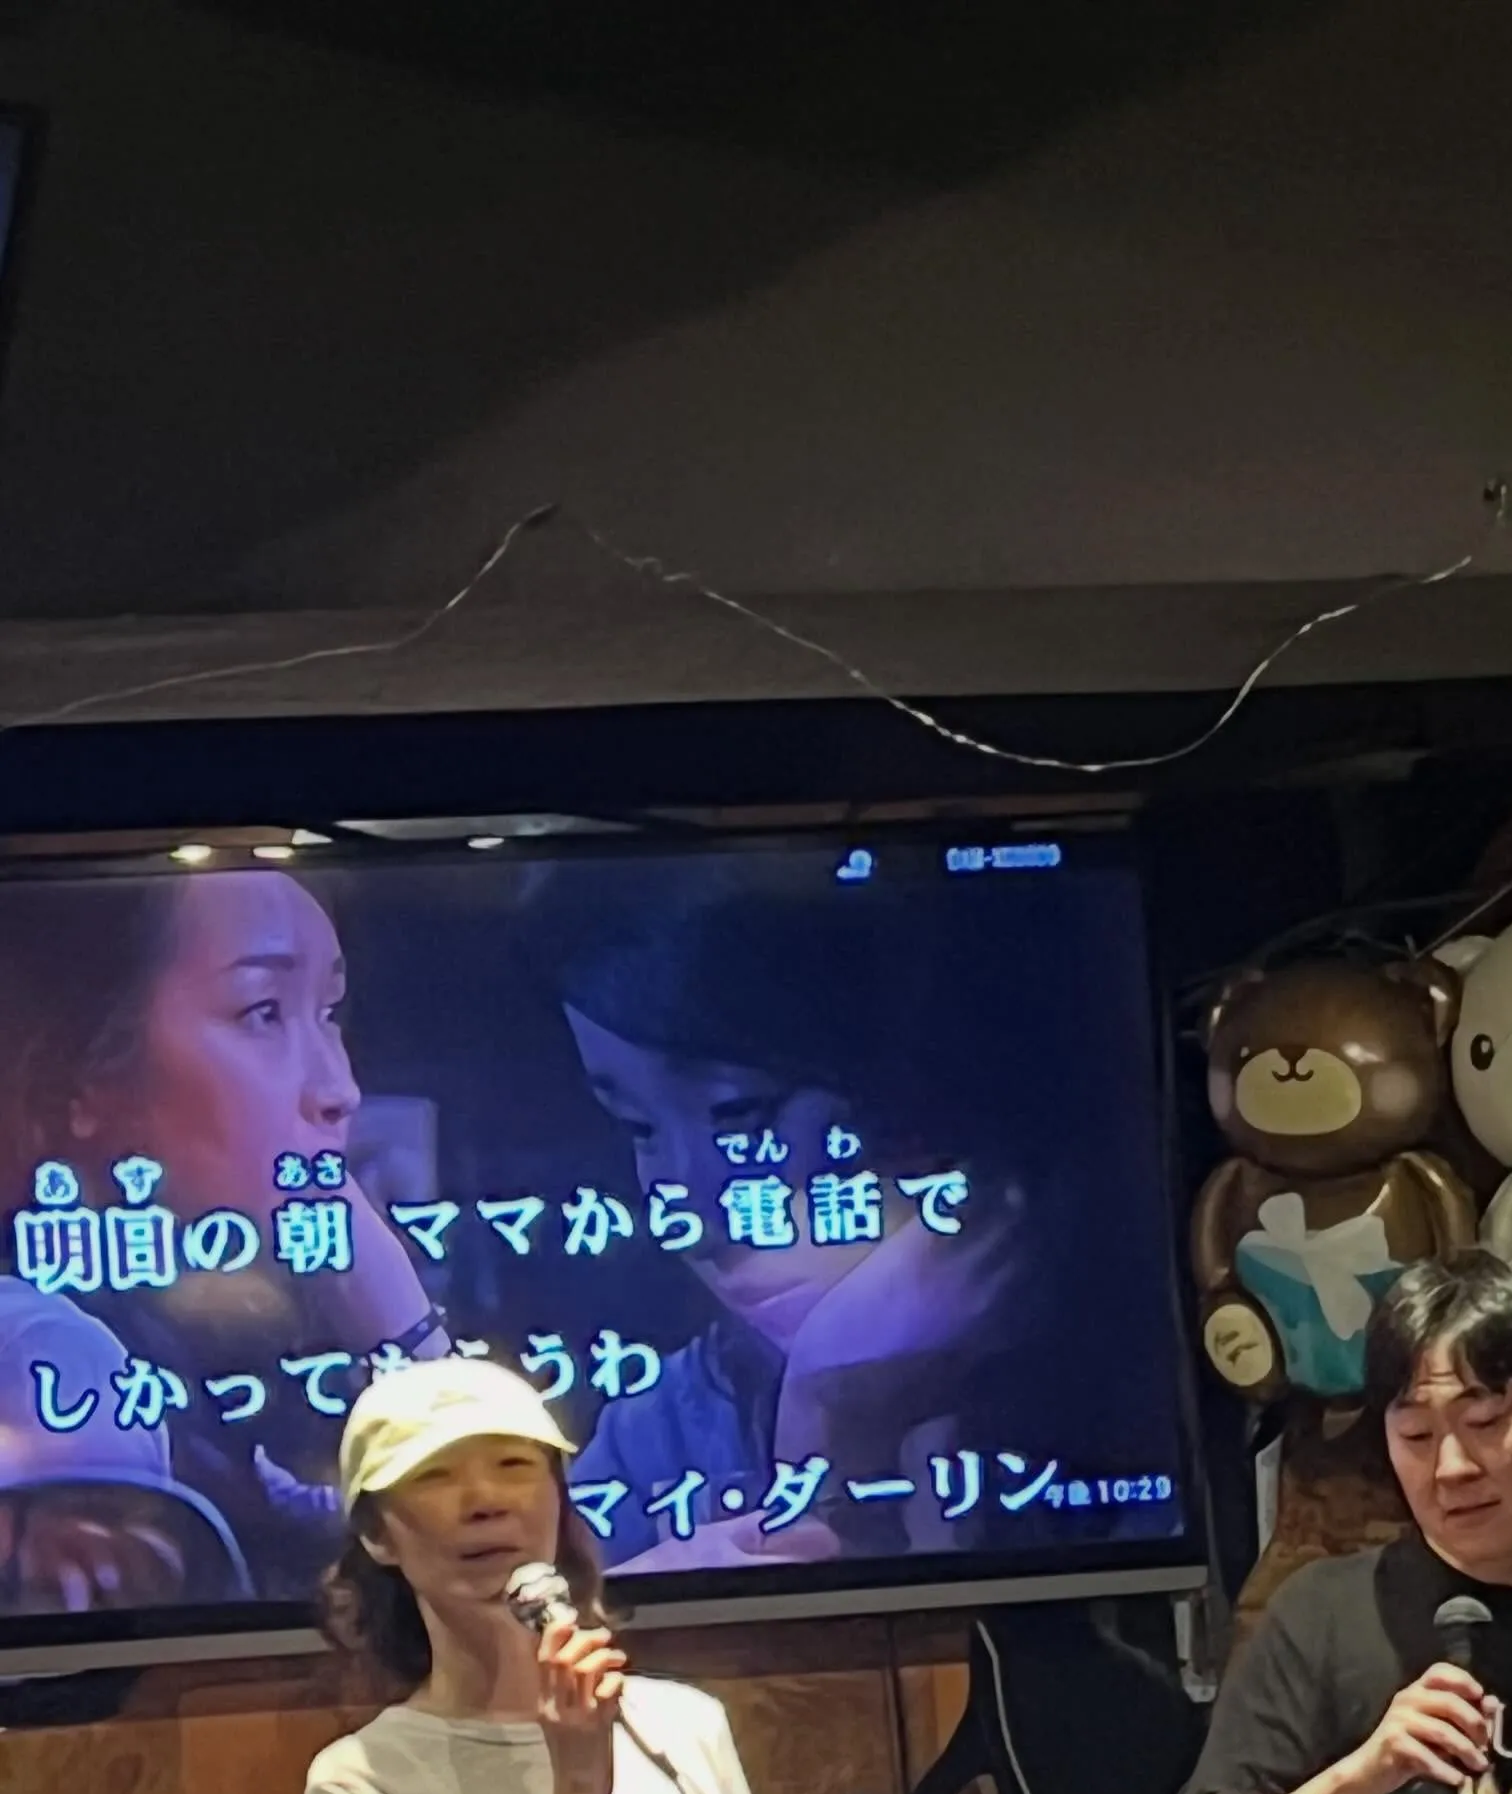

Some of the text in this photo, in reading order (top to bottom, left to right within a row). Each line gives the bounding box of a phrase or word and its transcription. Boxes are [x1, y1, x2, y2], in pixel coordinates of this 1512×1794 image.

[391, 1170, 969, 1261] ママから電話で
[33, 1328, 662, 1430] しかってうわ
